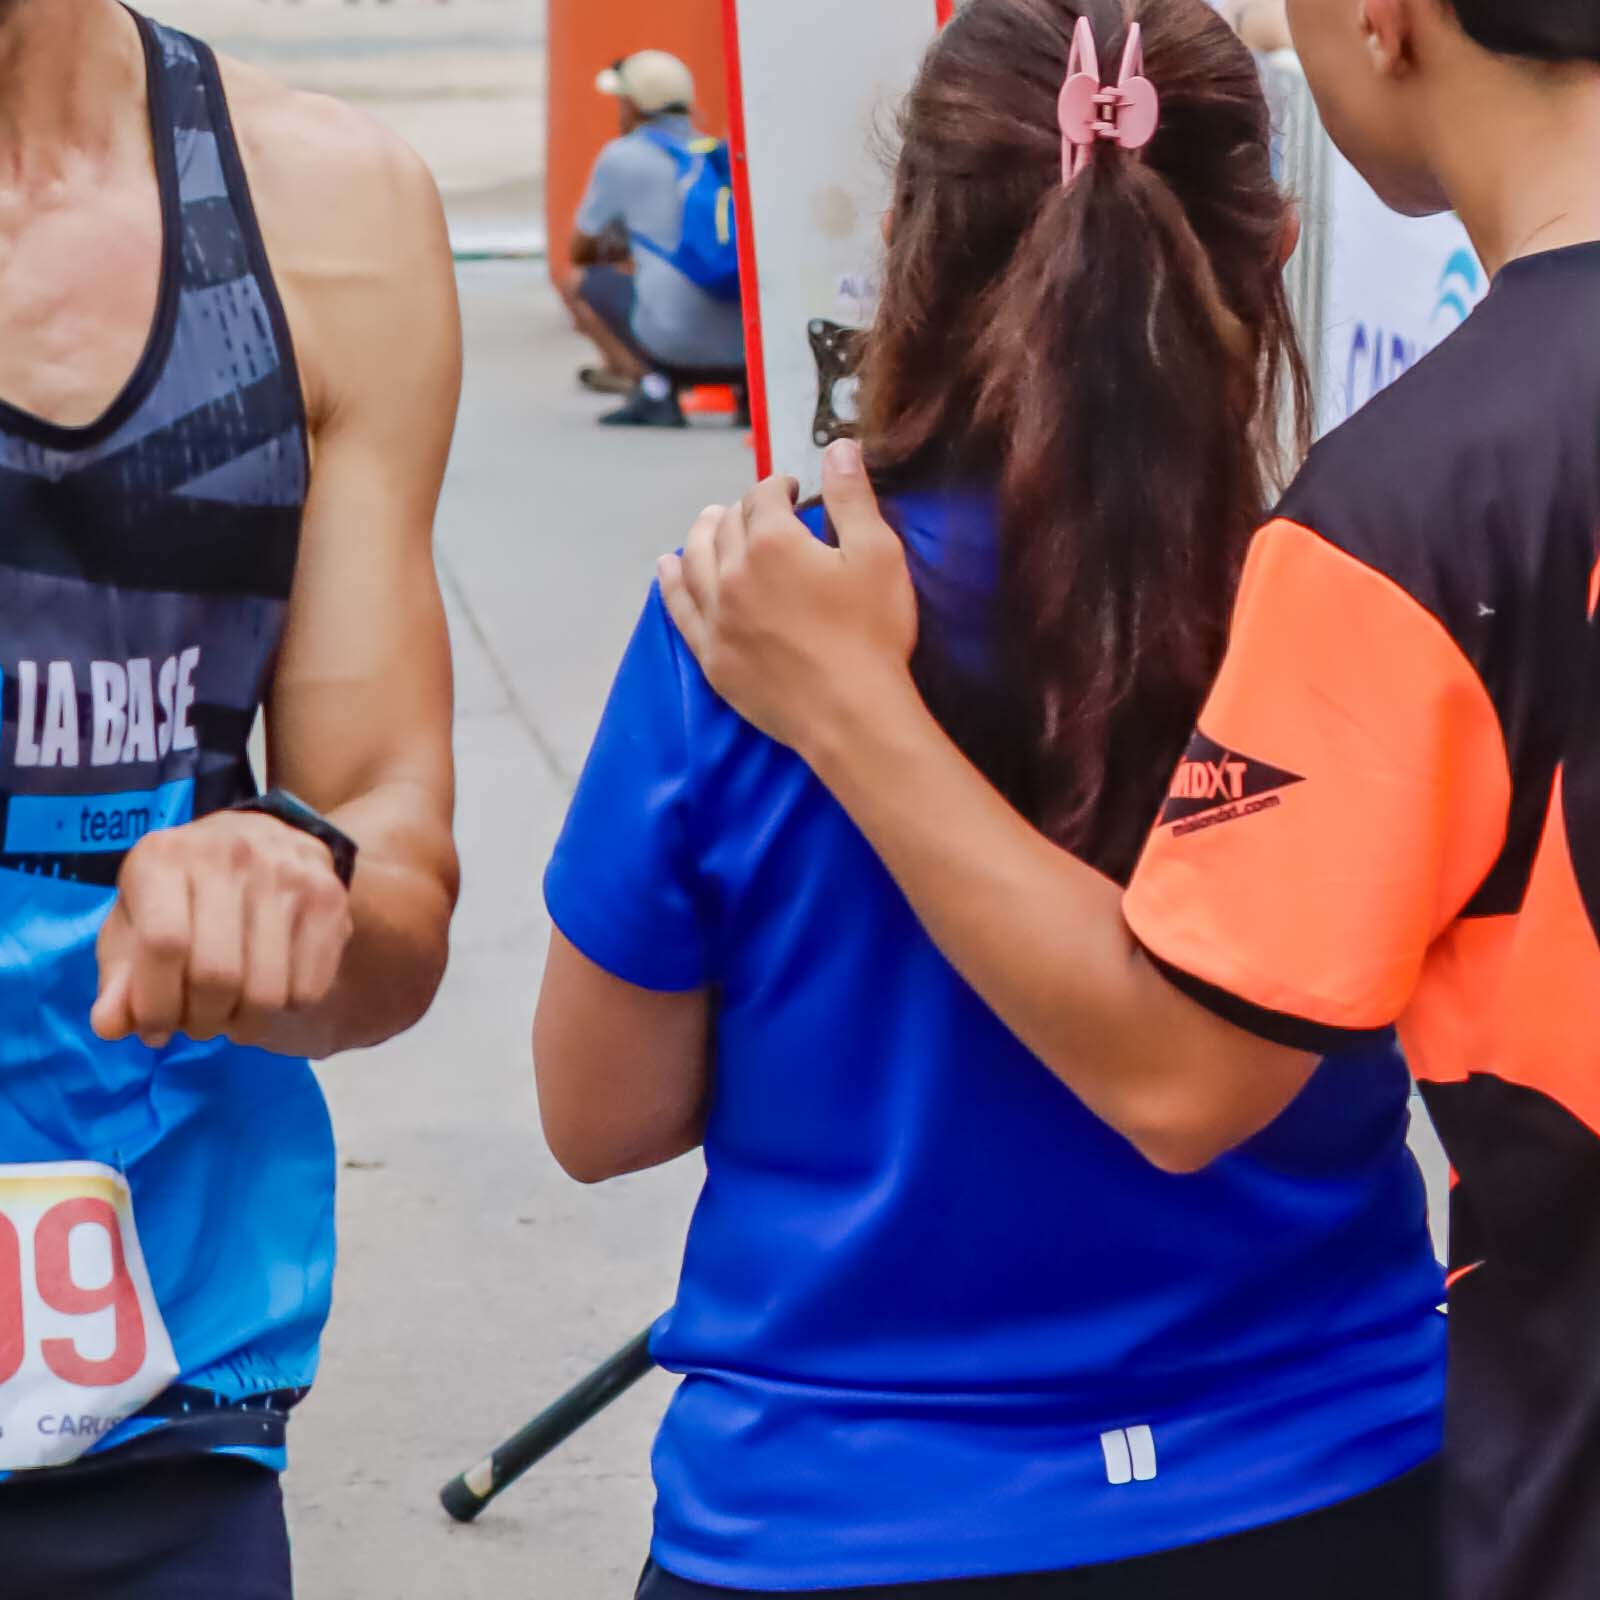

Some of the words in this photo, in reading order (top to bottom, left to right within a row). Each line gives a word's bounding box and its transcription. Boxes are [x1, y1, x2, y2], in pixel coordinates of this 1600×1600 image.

[14, 660, 79, 767] LA
[90, 644, 199, 766] BASE
[80, 803, 150, 842] team
